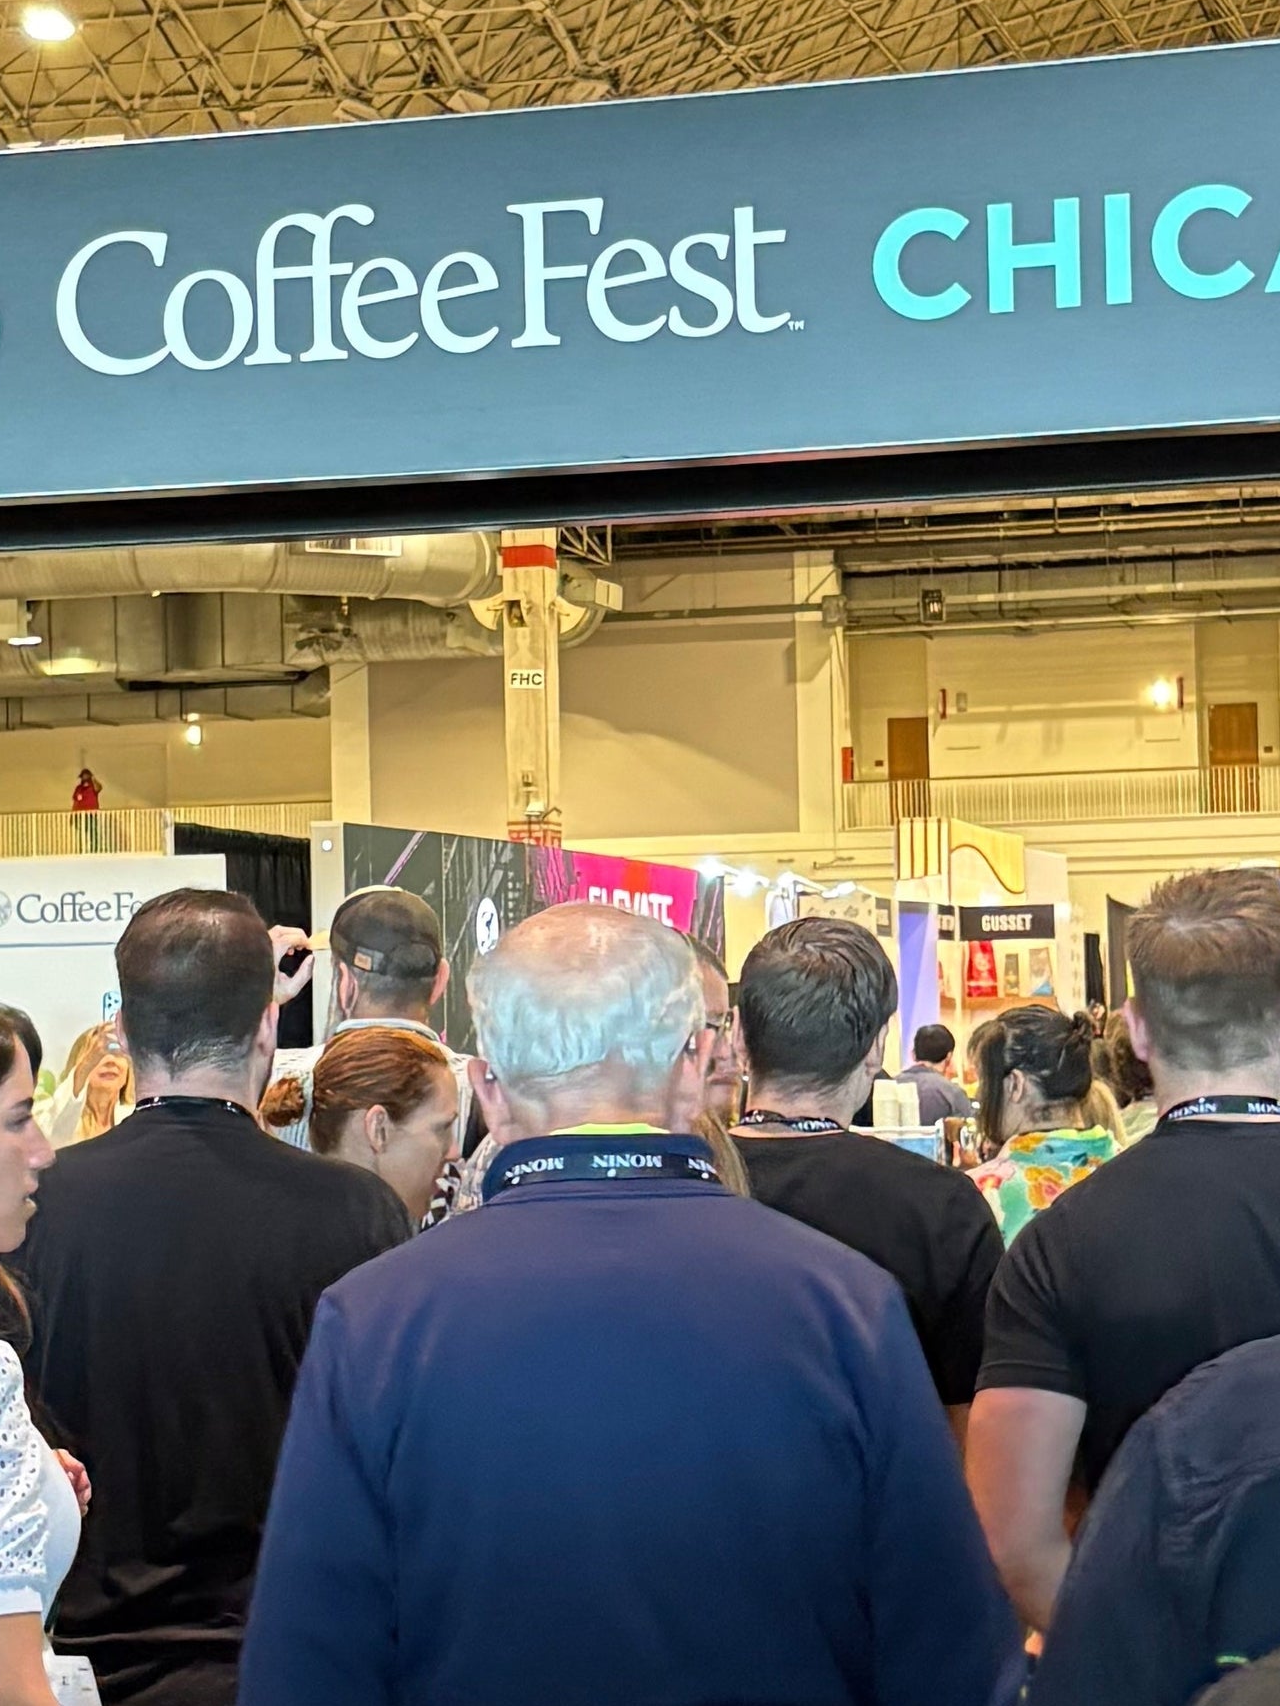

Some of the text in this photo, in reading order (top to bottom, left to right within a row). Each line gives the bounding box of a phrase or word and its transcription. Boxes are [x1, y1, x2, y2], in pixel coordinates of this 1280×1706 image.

[510, 672, 543, 686] FHC
[981, 913, 1033, 932] GUSSET
[592, 1153, 663, 1178] MONIN
